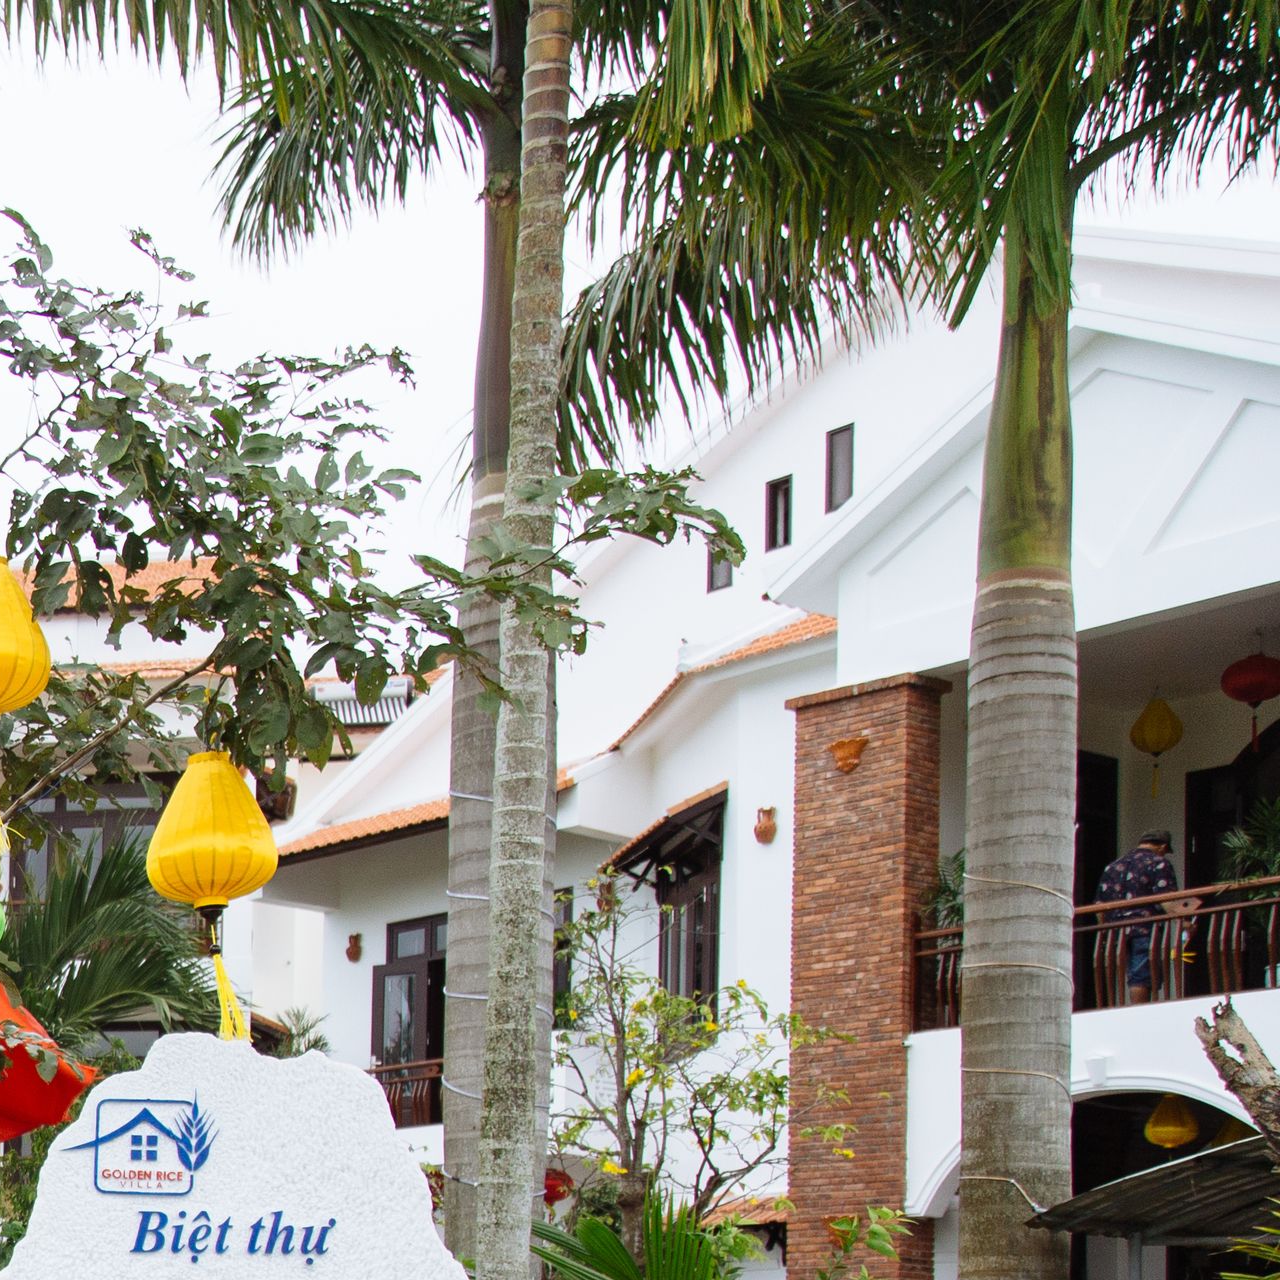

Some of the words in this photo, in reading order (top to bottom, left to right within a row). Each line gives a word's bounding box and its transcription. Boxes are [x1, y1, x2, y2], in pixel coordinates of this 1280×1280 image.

[101, 1168, 152, 1181] GOLDEN
[156, 1170, 183, 1182] RICE
[120, 1180, 163, 1189] VILLA
[130, 1210, 232, 1264] Biệt
[247, 1210, 337, 1266] thự
